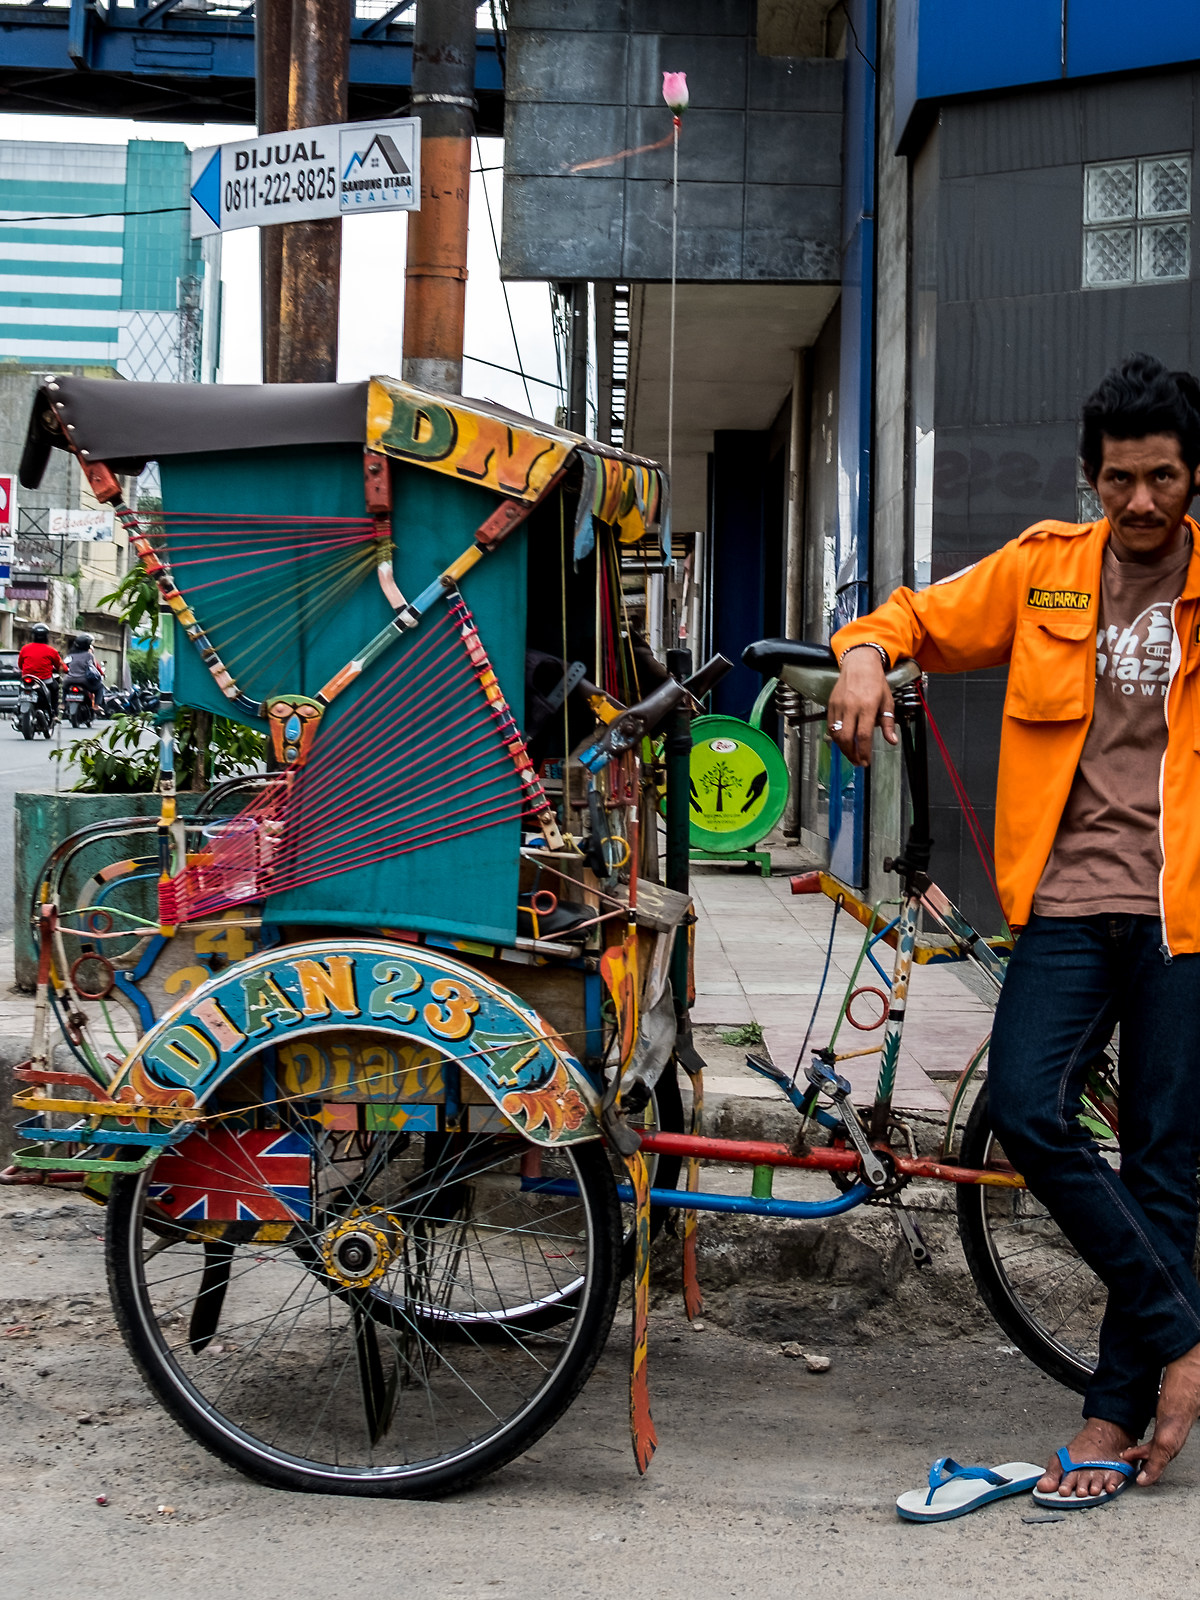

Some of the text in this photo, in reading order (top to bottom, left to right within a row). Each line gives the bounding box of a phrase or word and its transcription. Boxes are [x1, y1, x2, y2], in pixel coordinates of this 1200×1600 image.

[235, 141, 325, 172] DIJUAL
[225, 167, 336, 212] 0811-222-8825
[342, 175, 412, 193] BANDUNG UTARA
[342, 187, 413, 205] REALTY
[1054, 591, 1089, 609] PARKIR
[278, 1042, 447, 1098] Dian
